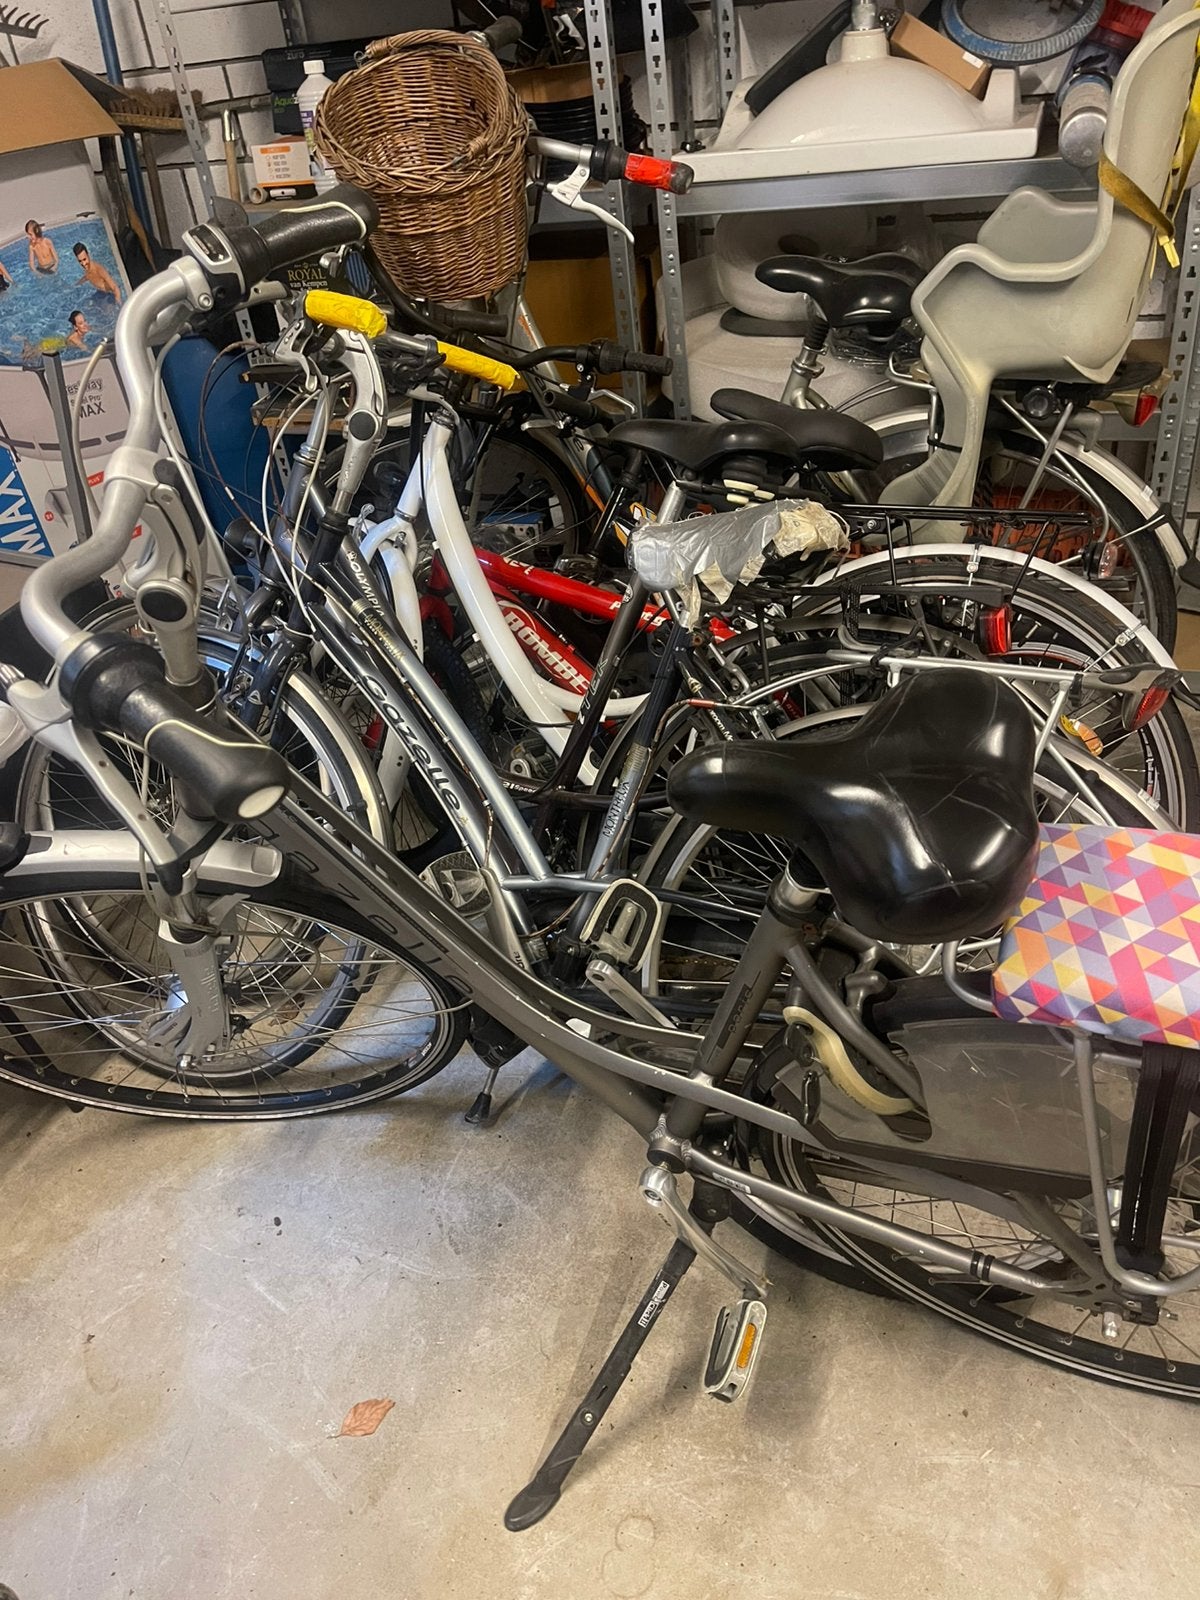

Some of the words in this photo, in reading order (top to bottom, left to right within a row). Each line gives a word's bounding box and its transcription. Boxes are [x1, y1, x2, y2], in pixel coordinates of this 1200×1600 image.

[287, 267, 327, 281] ROYAL
[302, 279, 328, 289] Kempen
[80, 401, 106, 419] MAX
[0, 470, 46, 554] MAX
[353, 674, 461, 811] Gazelle
